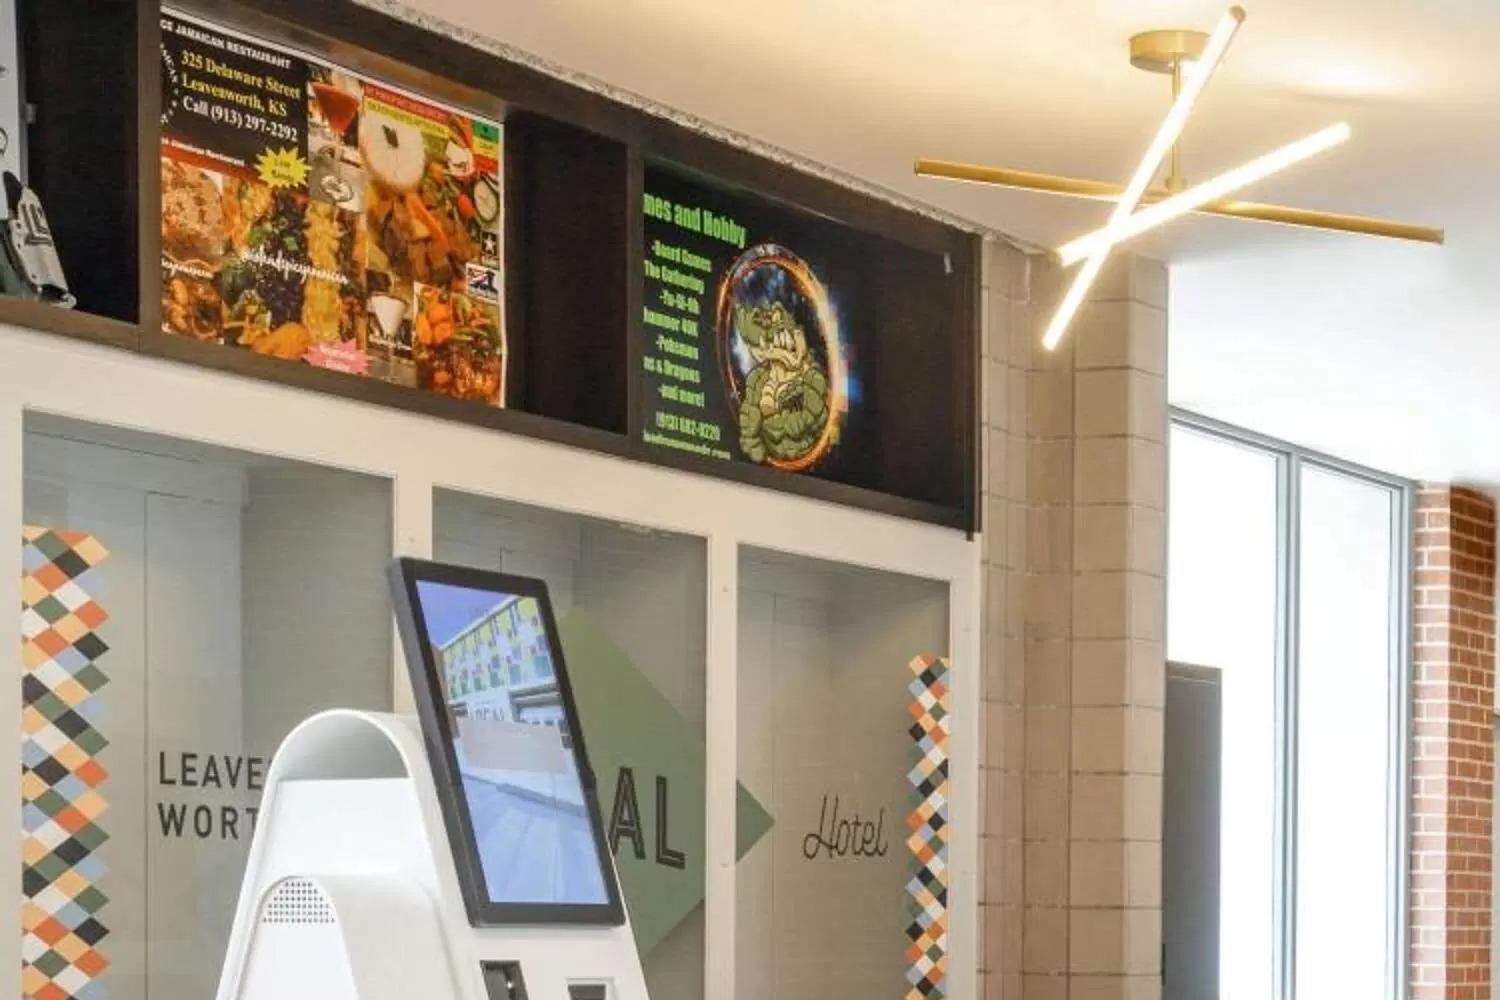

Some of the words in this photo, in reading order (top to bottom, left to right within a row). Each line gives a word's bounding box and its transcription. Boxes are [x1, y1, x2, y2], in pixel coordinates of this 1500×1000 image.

[175, 24, 225, 49] JAMAICAN
[226, 40, 292, 69] RESTAURANT
[181, 50, 203, 69] 325
[205, 57, 263, 88] Delaware
[265, 76, 301, 100] Street
[182, 72, 266, 112] Leavenworth,
[268, 98, 288, 117] KS
[183, 95, 209, 118] Call
[210, 104, 243, 128] (913)
[244, 113, 299, 143] 297-2292
[673, 203, 701, 232] and
[702, 209, 746, 249] Hobby
[158, 751, 272, 790] LEAVE
[802, 791, 890, 861] Hotel
